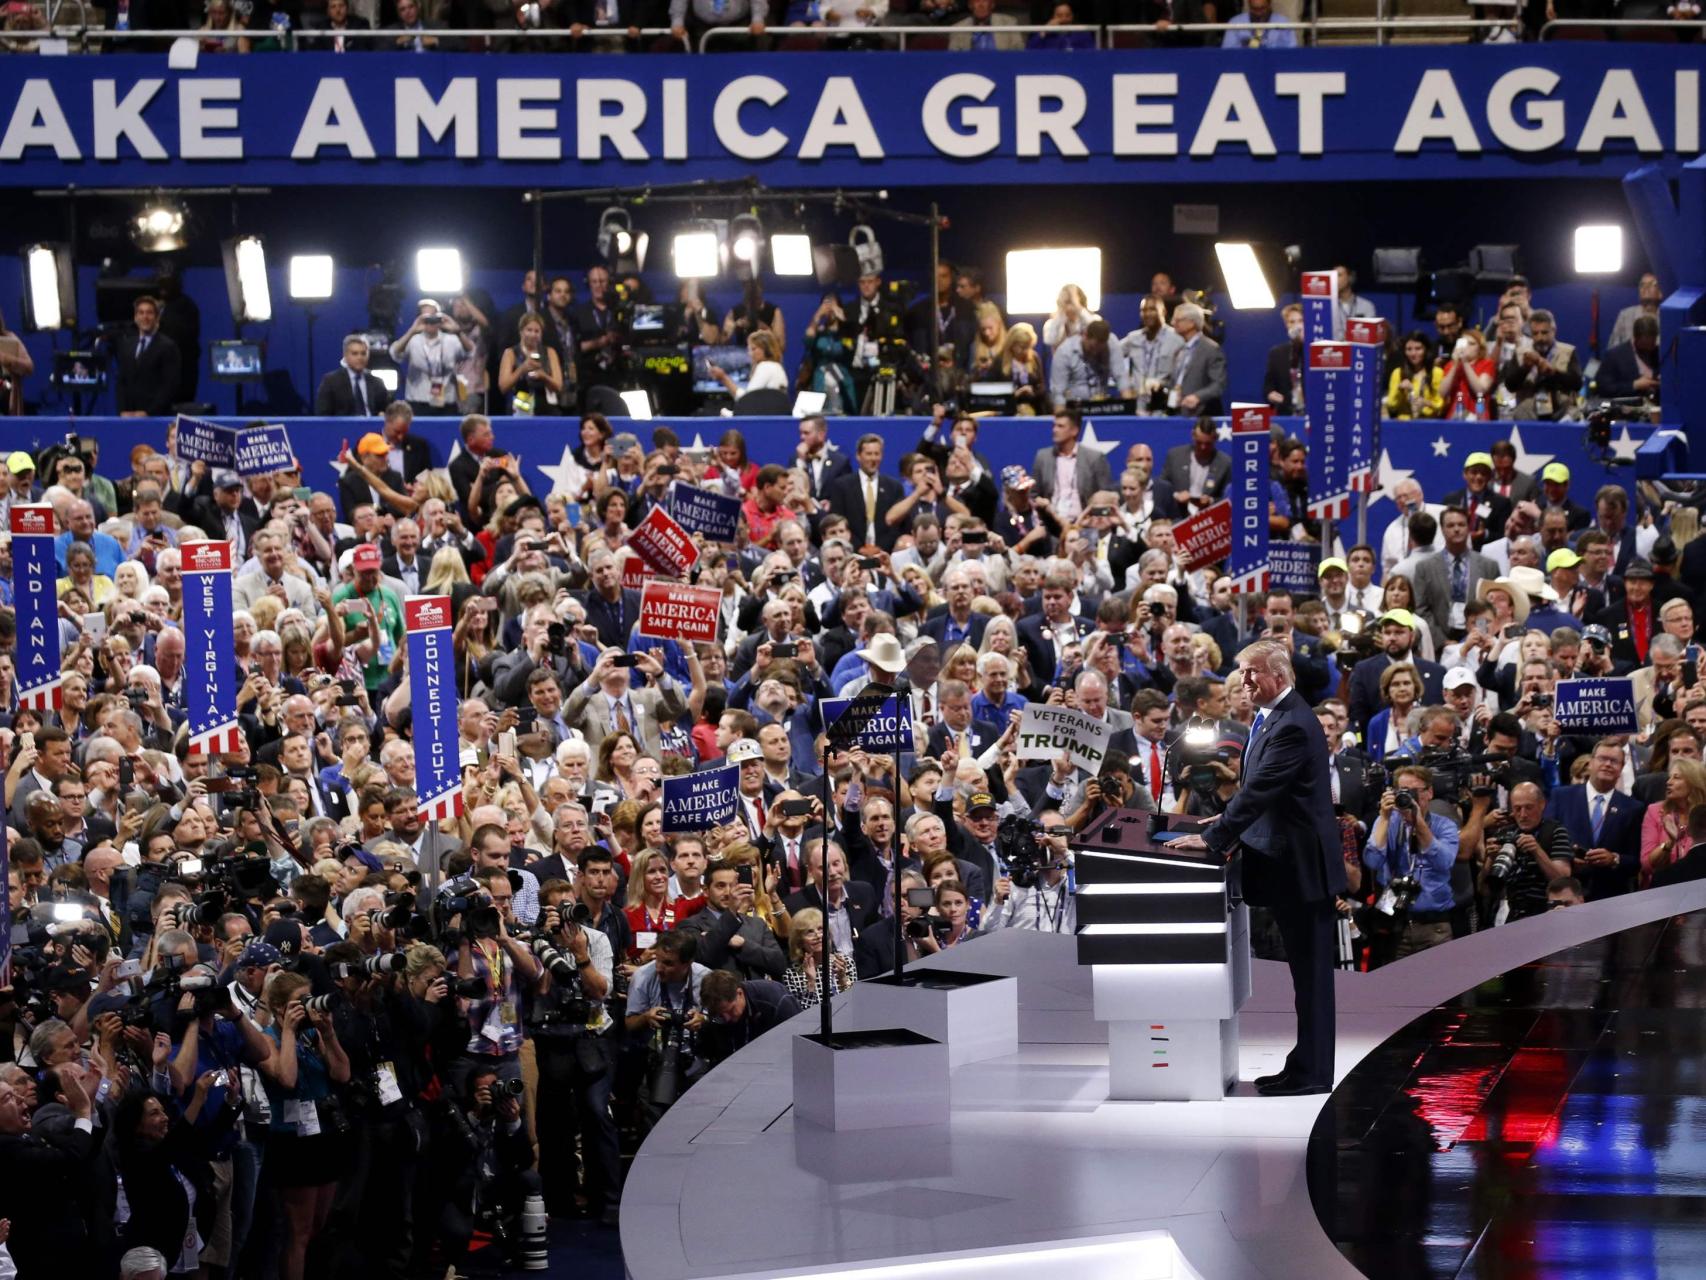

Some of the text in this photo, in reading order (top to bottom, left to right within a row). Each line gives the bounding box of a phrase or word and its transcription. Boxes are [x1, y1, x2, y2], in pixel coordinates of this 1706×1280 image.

[291, 75, 885, 160] AMERICA
[921, 71, 1347, 159] GREAT
[1352, 348, 1364, 458] LOUISIANA
[194, 427, 215, 439] MAKE
[1324, 372, 1336, 485] MISSISSIPPI
[177, 431, 234, 454] AMERICA
[247, 434, 269, 445] MAKE
[181, 445, 229, 463] SAFE AGAIN
[238, 454, 288, 470] SAFE AGAIN
[693, 495, 718, 508] MAKE
[1244, 440, 1258, 547] OREGON
[672, 500, 736, 528] AMERICA
[675, 514, 730, 535] SAFE AGAIN
[1191, 516, 1214, 533] MAKE
[641, 521, 691, 575] AMERICA
[665, 526, 686, 550] MAKE
[1291, 551, 1311, 560] OUR
[1283, 575, 1315, 585] AGAIN
[27, 543, 46, 665] INDIANA
[668, 591, 695, 604] MAKE
[643, 600, 716, 622] AMERICA
[647, 617, 709, 633] SAFE AGAIN
[201, 575, 220, 715] WEST VIRGINIA
[1579, 688, 1607, 698] MAKE
[425, 633, 445, 781] CONNECTICUT
[851, 705, 882, 716] MAKE
[1556, 699, 1634, 716] AMERICA
[1033, 710, 1103, 736] VETERANS
[1053, 725, 1077, 737] FOR
[1562, 715, 1629, 728] SAFE AGAIN
[1020, 734, 1103, 761] TRUMP
[692, 779, 720, 793] MAKE
[665, 787, 739, 813] AMERICA
[671, 804, 734, 824] SAFE AGAIN
